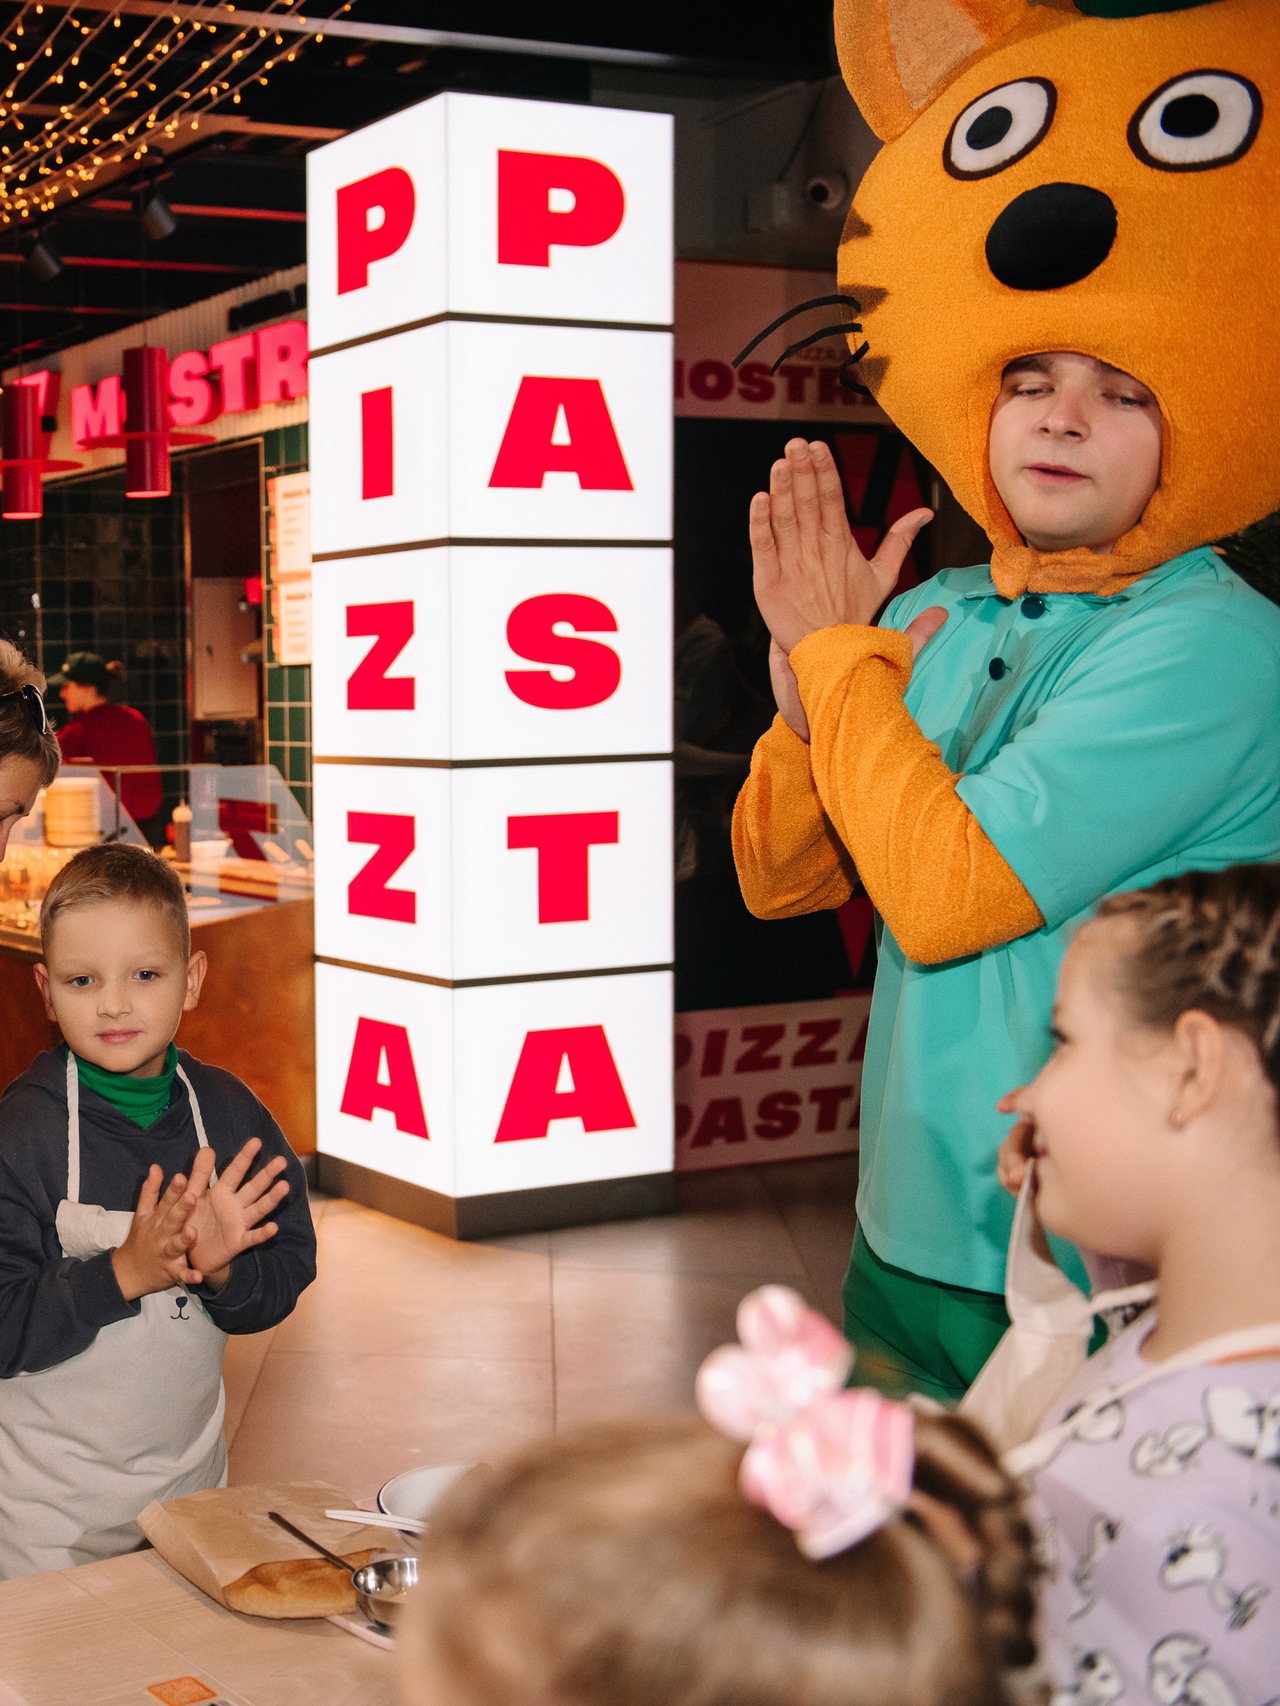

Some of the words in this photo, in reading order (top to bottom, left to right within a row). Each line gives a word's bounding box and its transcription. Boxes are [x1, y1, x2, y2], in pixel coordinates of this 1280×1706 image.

[71, 320, 309, 452] MSTR
[336, 166, 430, 1141] PIZZA
[486, 148, 637, 1144] PASTA
